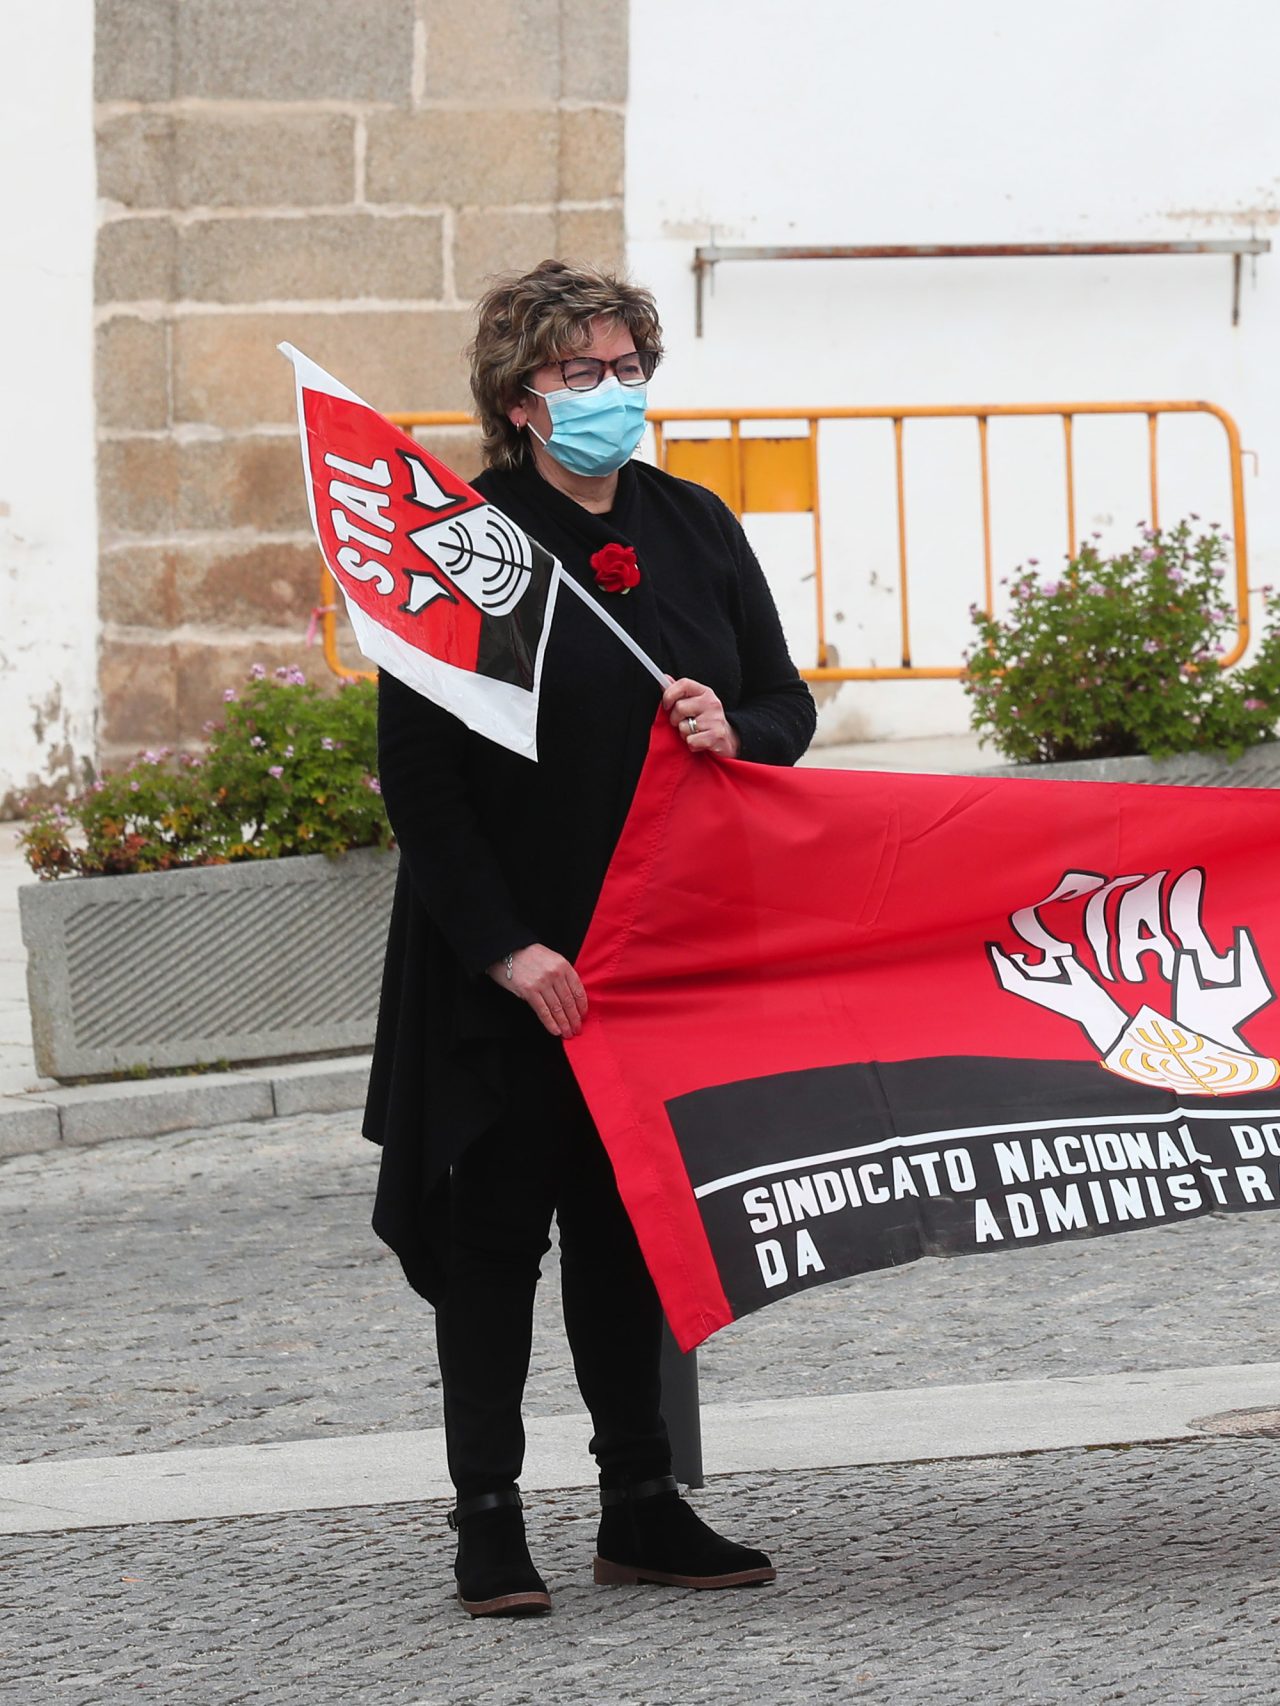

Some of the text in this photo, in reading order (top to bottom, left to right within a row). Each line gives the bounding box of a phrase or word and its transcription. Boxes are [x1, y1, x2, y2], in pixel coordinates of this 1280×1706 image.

[323, 451, 397, 596] STAL
[1009, 867, 1236, 984] STAL
[743, 1148, 977, 1234] SINDICATO
[993, 1124, 1212, 1186] NACIONAL
[755, 1229, 826, 1288] DA
